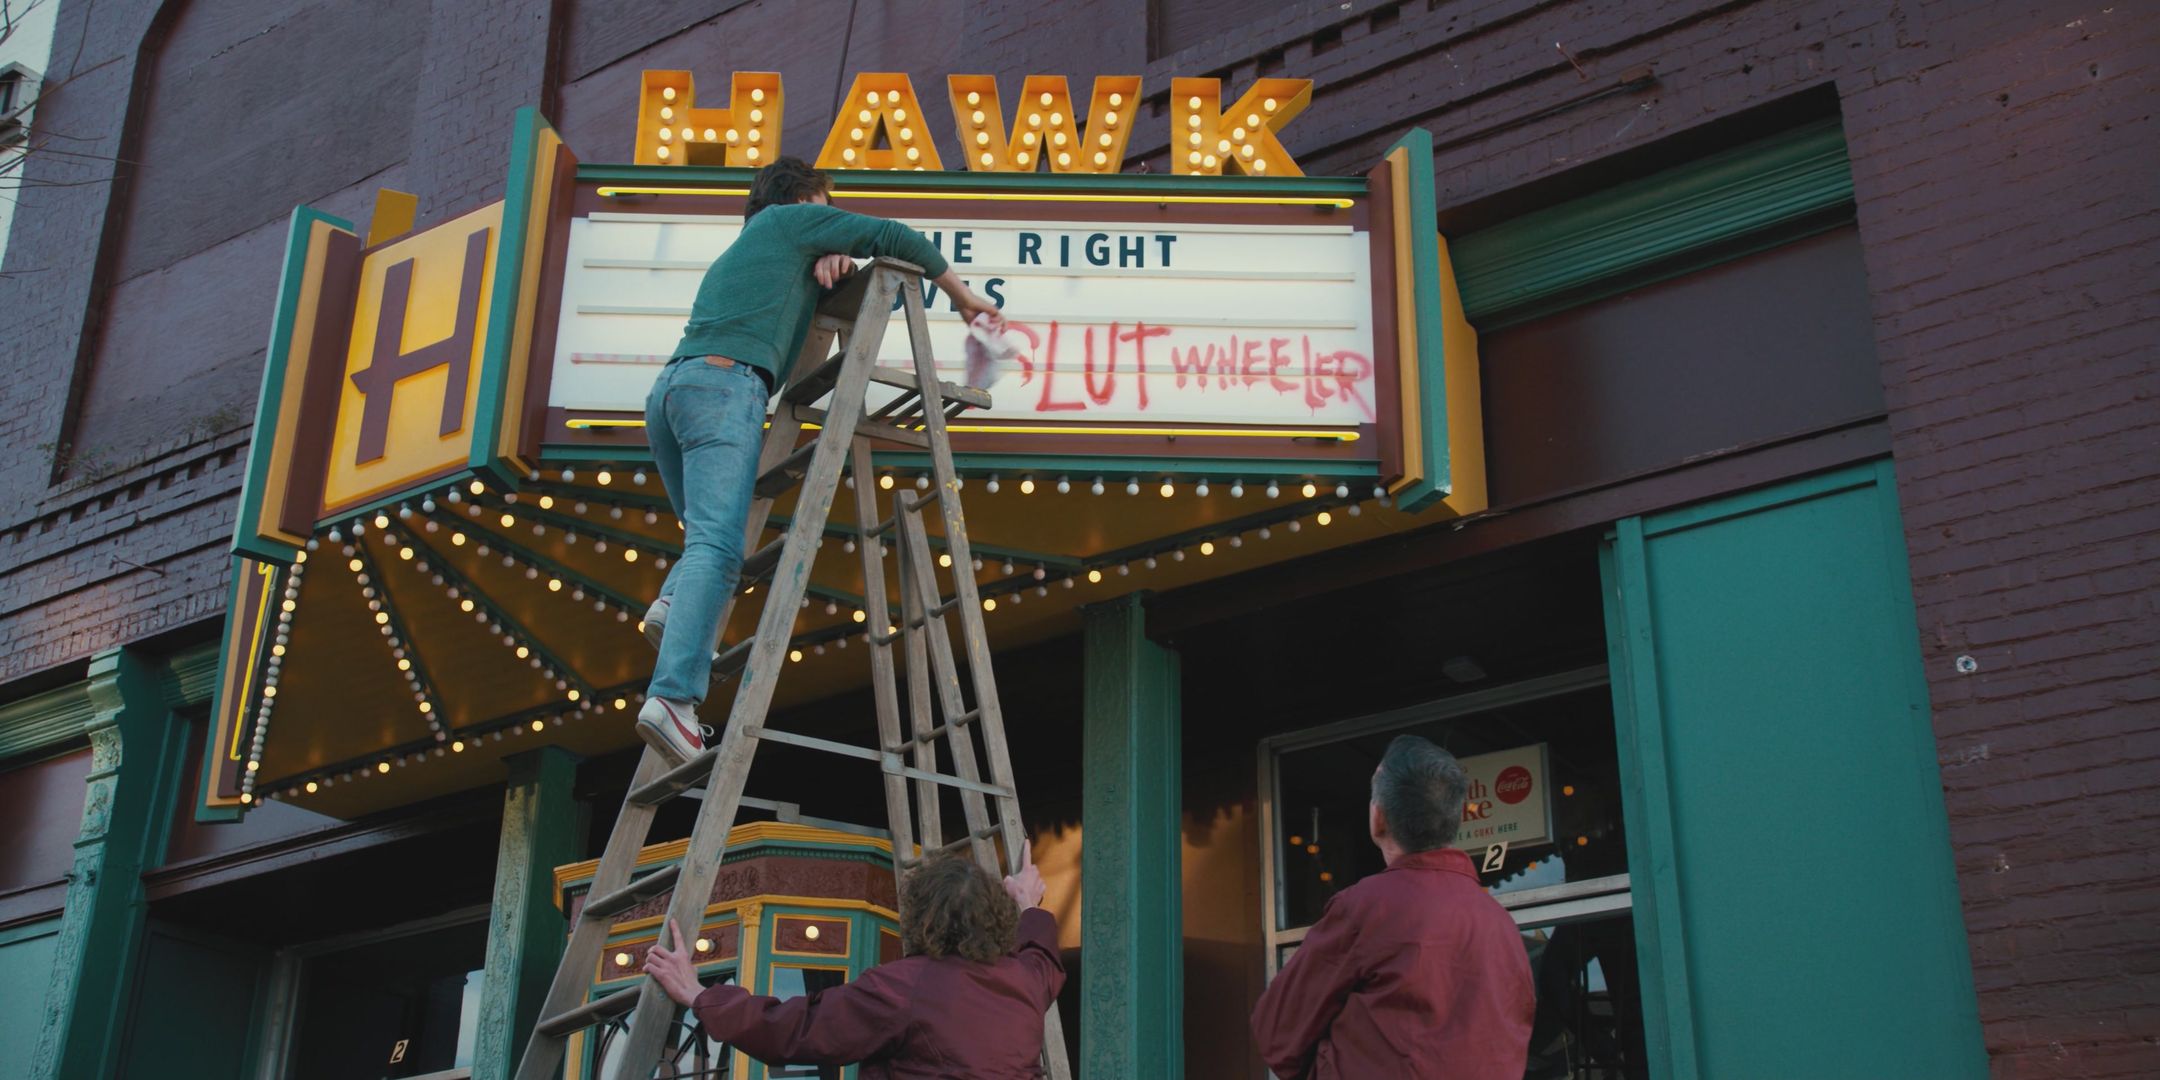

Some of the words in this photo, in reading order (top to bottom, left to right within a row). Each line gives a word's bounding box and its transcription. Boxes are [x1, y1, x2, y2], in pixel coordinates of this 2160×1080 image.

[633, 69, 1314, 177] HAWK
[1018, 232, 1177, 268] RIGHT
[350, 226, 490, 467] H
[1170, 333, 1377, 422] WHEELER
[1485, 844, 1503, 870] 2
[392, 1041, 405, 1062] 2
